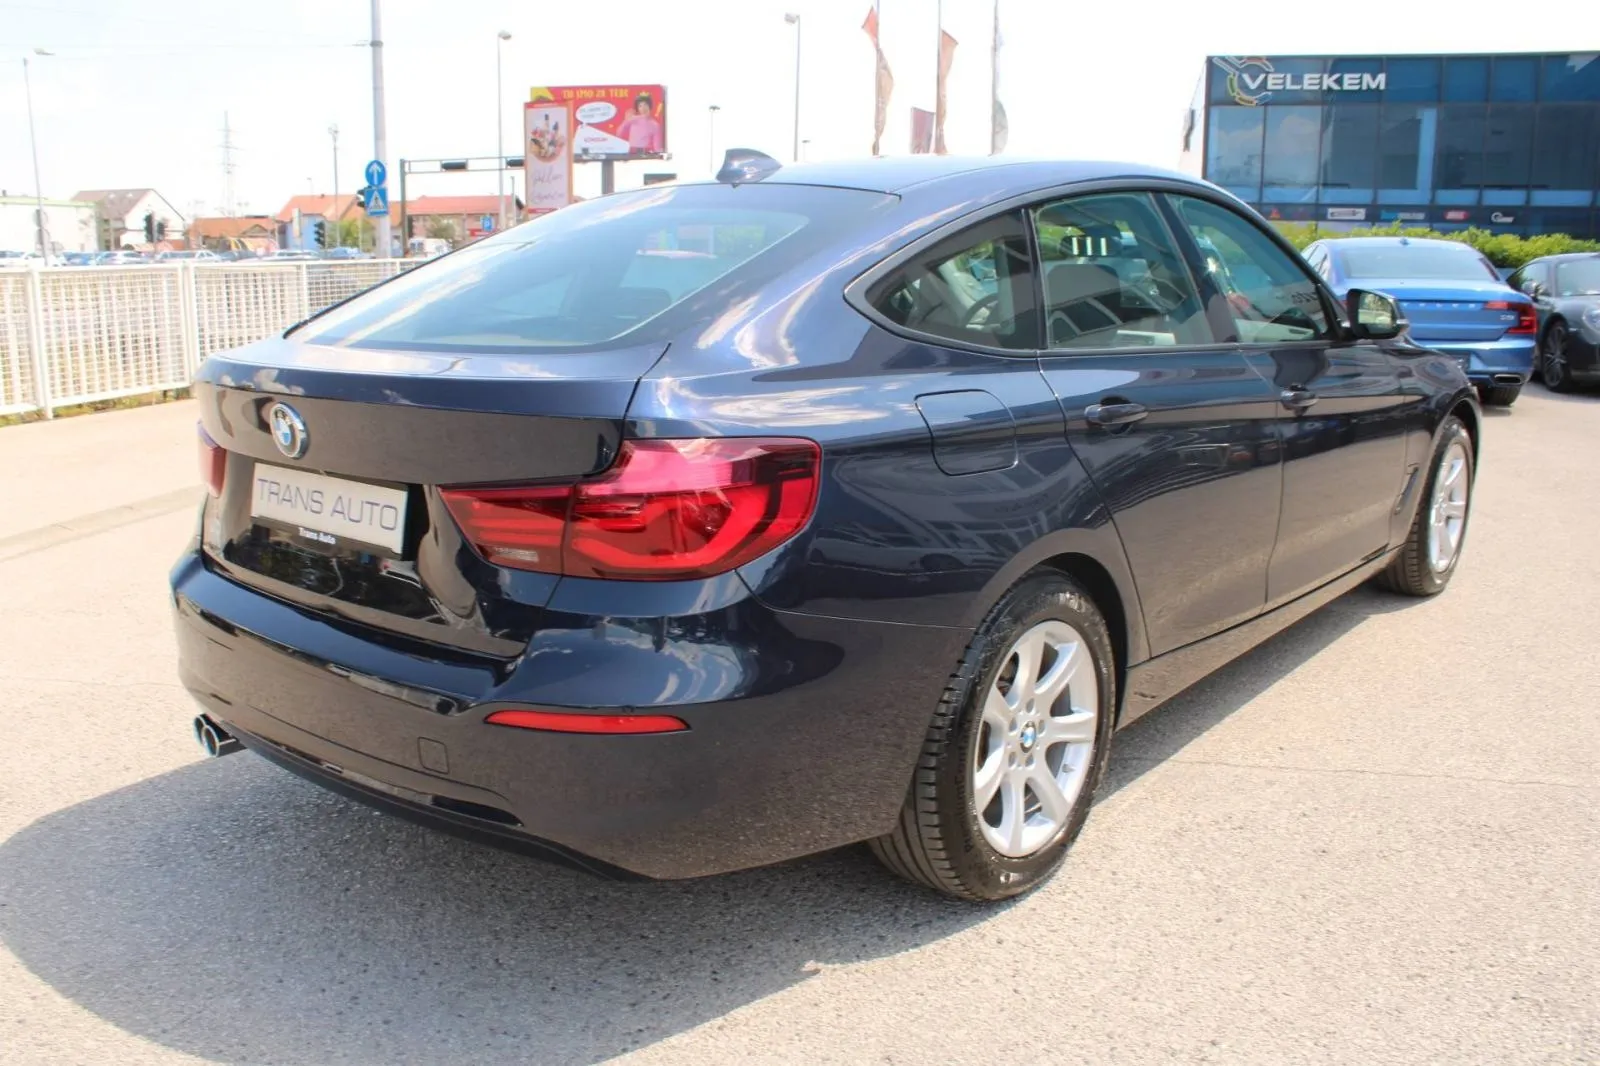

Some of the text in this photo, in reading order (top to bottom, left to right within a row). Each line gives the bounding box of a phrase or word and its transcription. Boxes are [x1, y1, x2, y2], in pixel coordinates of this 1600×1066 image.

[1241, 73, 1386, 90] VELEKEM
[257, 478, 399, 531] TRANS AUTO
